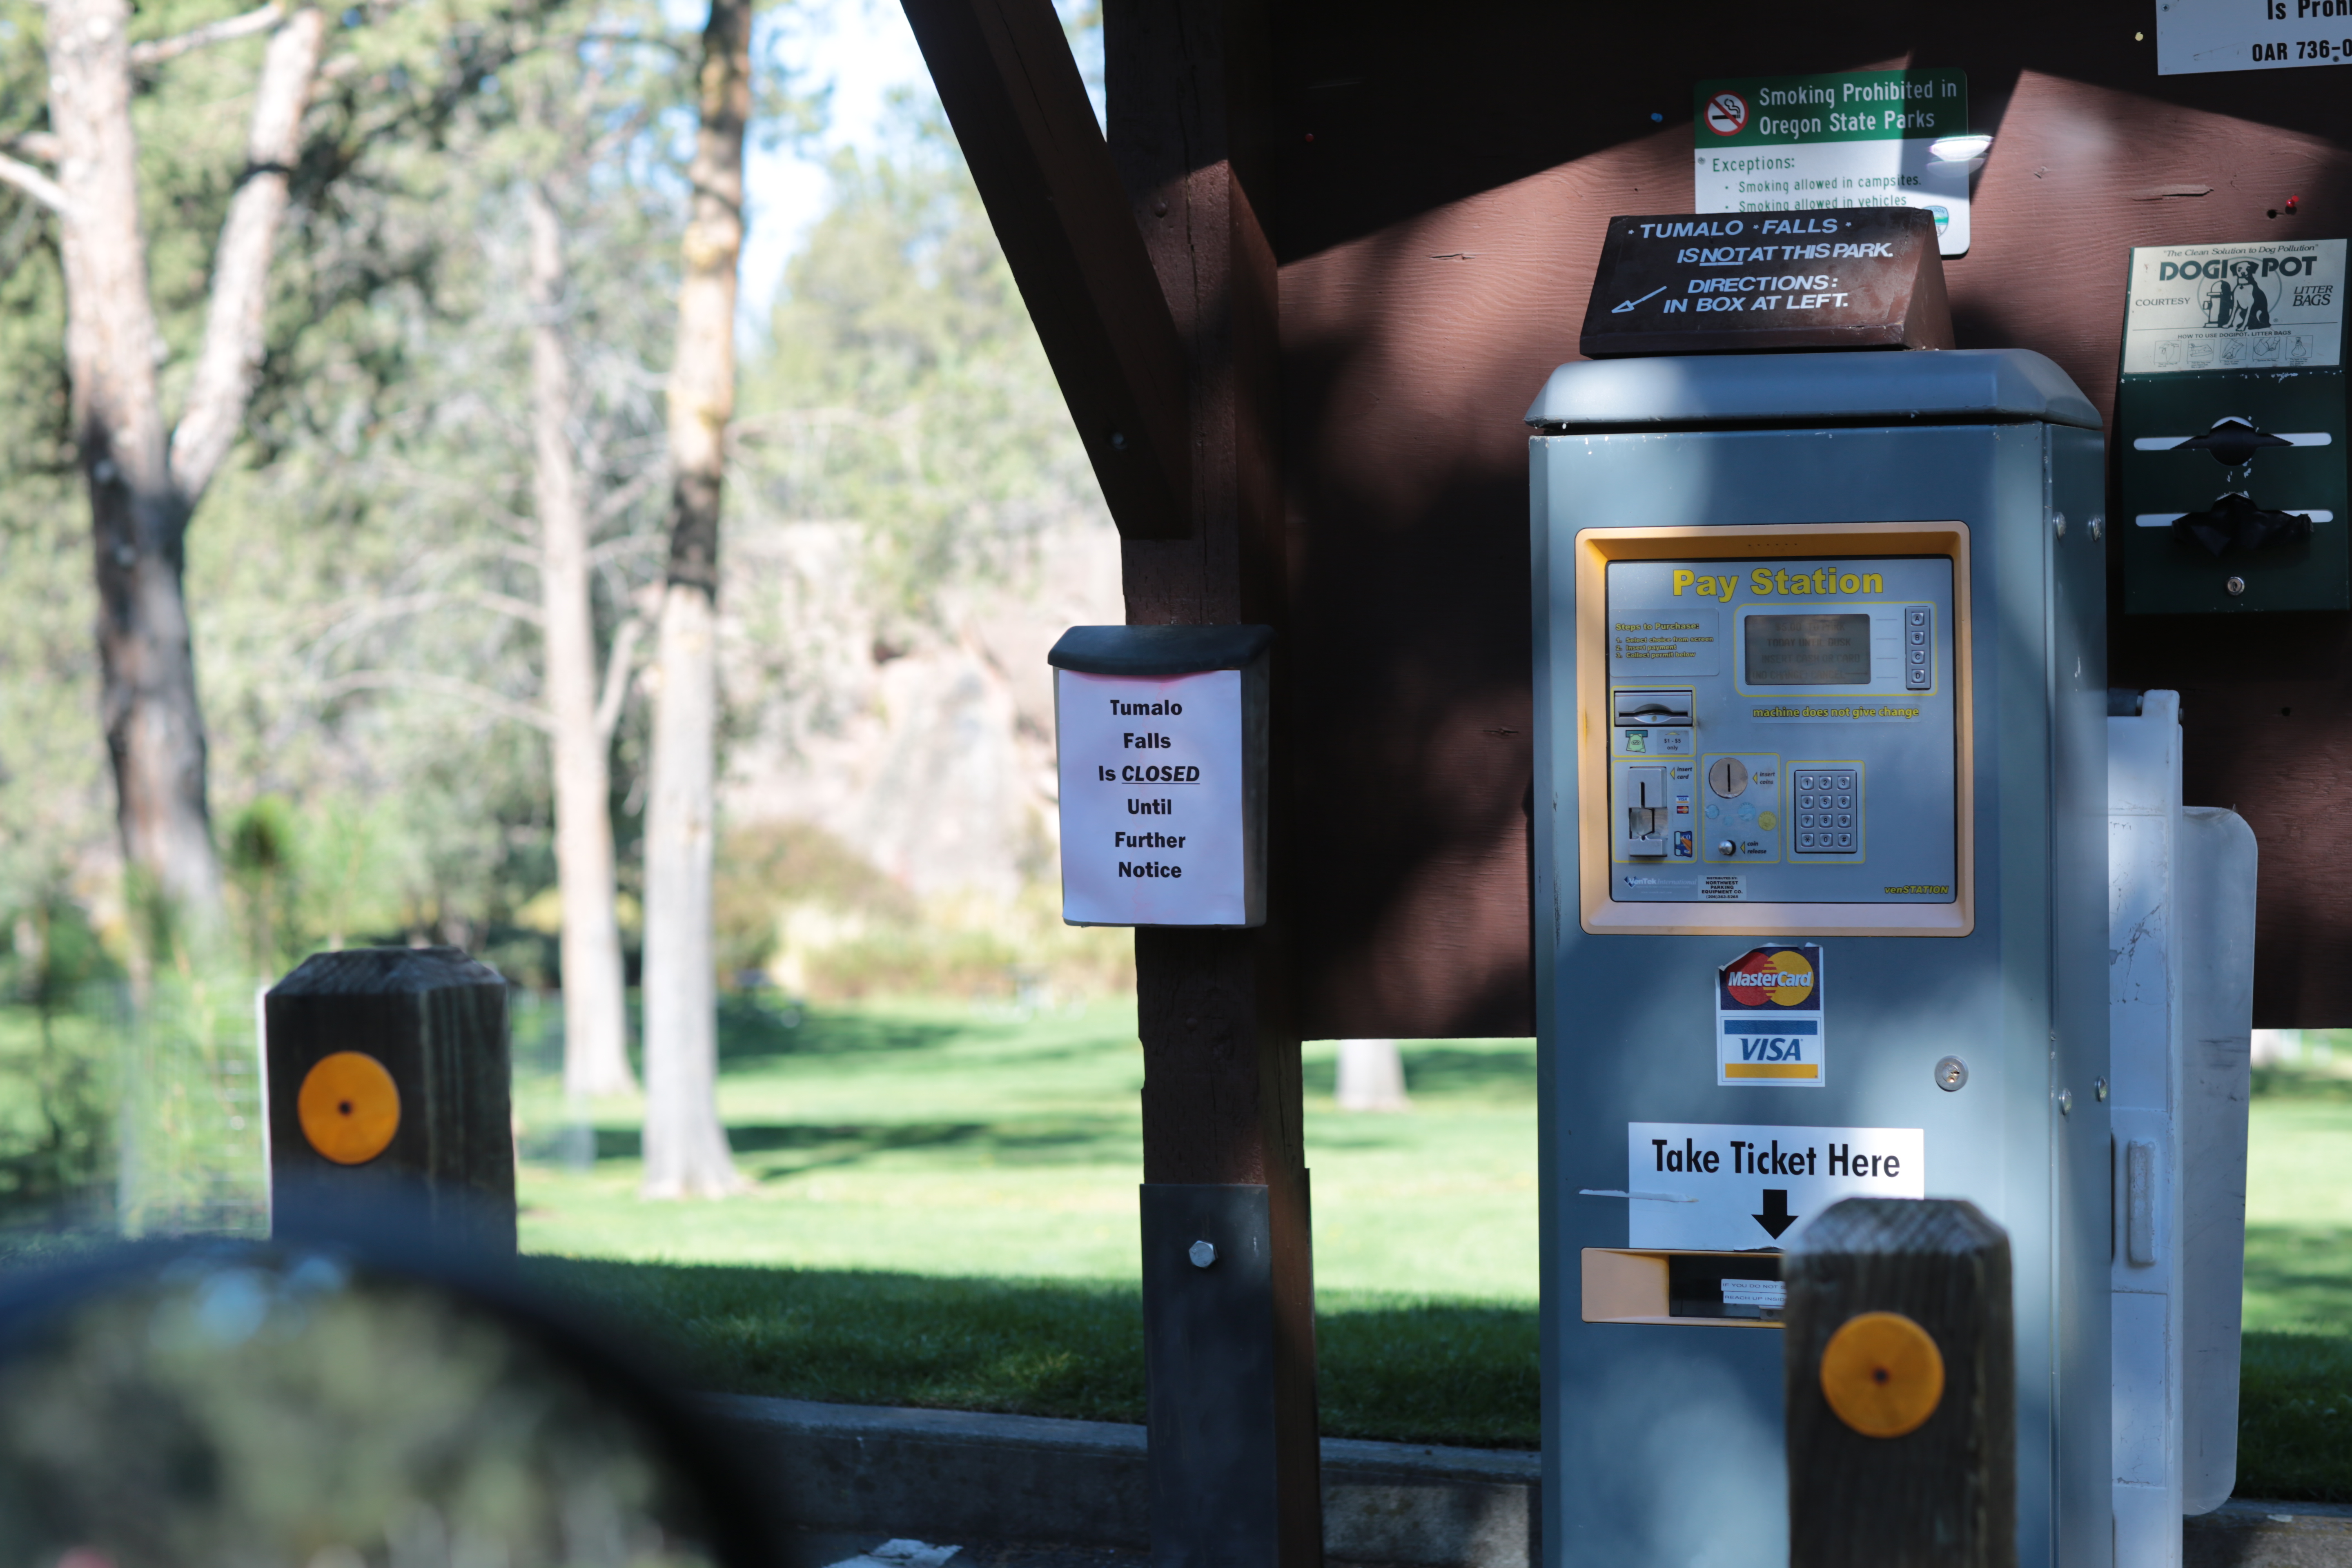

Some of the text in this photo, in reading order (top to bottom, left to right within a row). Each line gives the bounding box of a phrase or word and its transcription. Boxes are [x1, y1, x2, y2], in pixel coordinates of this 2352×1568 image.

[2267, 0, 2286, 20] Is
[2252, 38, 2352, 62] OAR 736-0
[1760, 79, 1956, 109] Smoking Prohibited in
[1760, 110, 1935, 139] Oregon State Parks
[1713, 156, 1795, 175] Exceptions:
[1739, 175, 1921, 194] Smoking allowed in campsites.
[1739, 195, 1907, 212] Smoking allowed in vehicles
[1640, 218, 1838, 238] TUMALO FALLS
[1677, 243, 1893, 263] IS NOT AT THIS PARK.
[2278, 244, 2319, 252] Pollution"
[2262, 256, 2317, 277] POT
[1688, 274, 1838, 294] DIRECTIONS:
[2294, 285, 2333, 294] LITTER
[1663, 292, 1849, 313] IN BOX AT LEFT.
[2135, 297, 2191, 307] COURTESY
[2292, 294, 2331, 307] BAGS
[1673, 567, 1883, 603] Pay Station
[1615, 623, 1641, 632] Steps
[1767, 638, 1851, 646] TODAY UNTIL DUSK
[1762, 654, 1860, 663] INSERT CASH OR CARD
[1110, 699, 1183, 715] Tumalo
[1753, 706, 1919, 719] machine does not give change
[1123, 733, 1171, 748] Falls
[1098, 765, 1200, 782] Is CLOSED
[1127, 798, 1172, 815] Until
[1115, 832, 1186, 848] Further
[1118, 862, 1182, 878] Notice
[1885, 885, 1949, 894] venSTATION
[1728, 971, 1812, 987] MasterCard
[1738, 1038, 1801, 1061] VISA
[1652, 1138, 1900, 1178] Take Ticket Here
